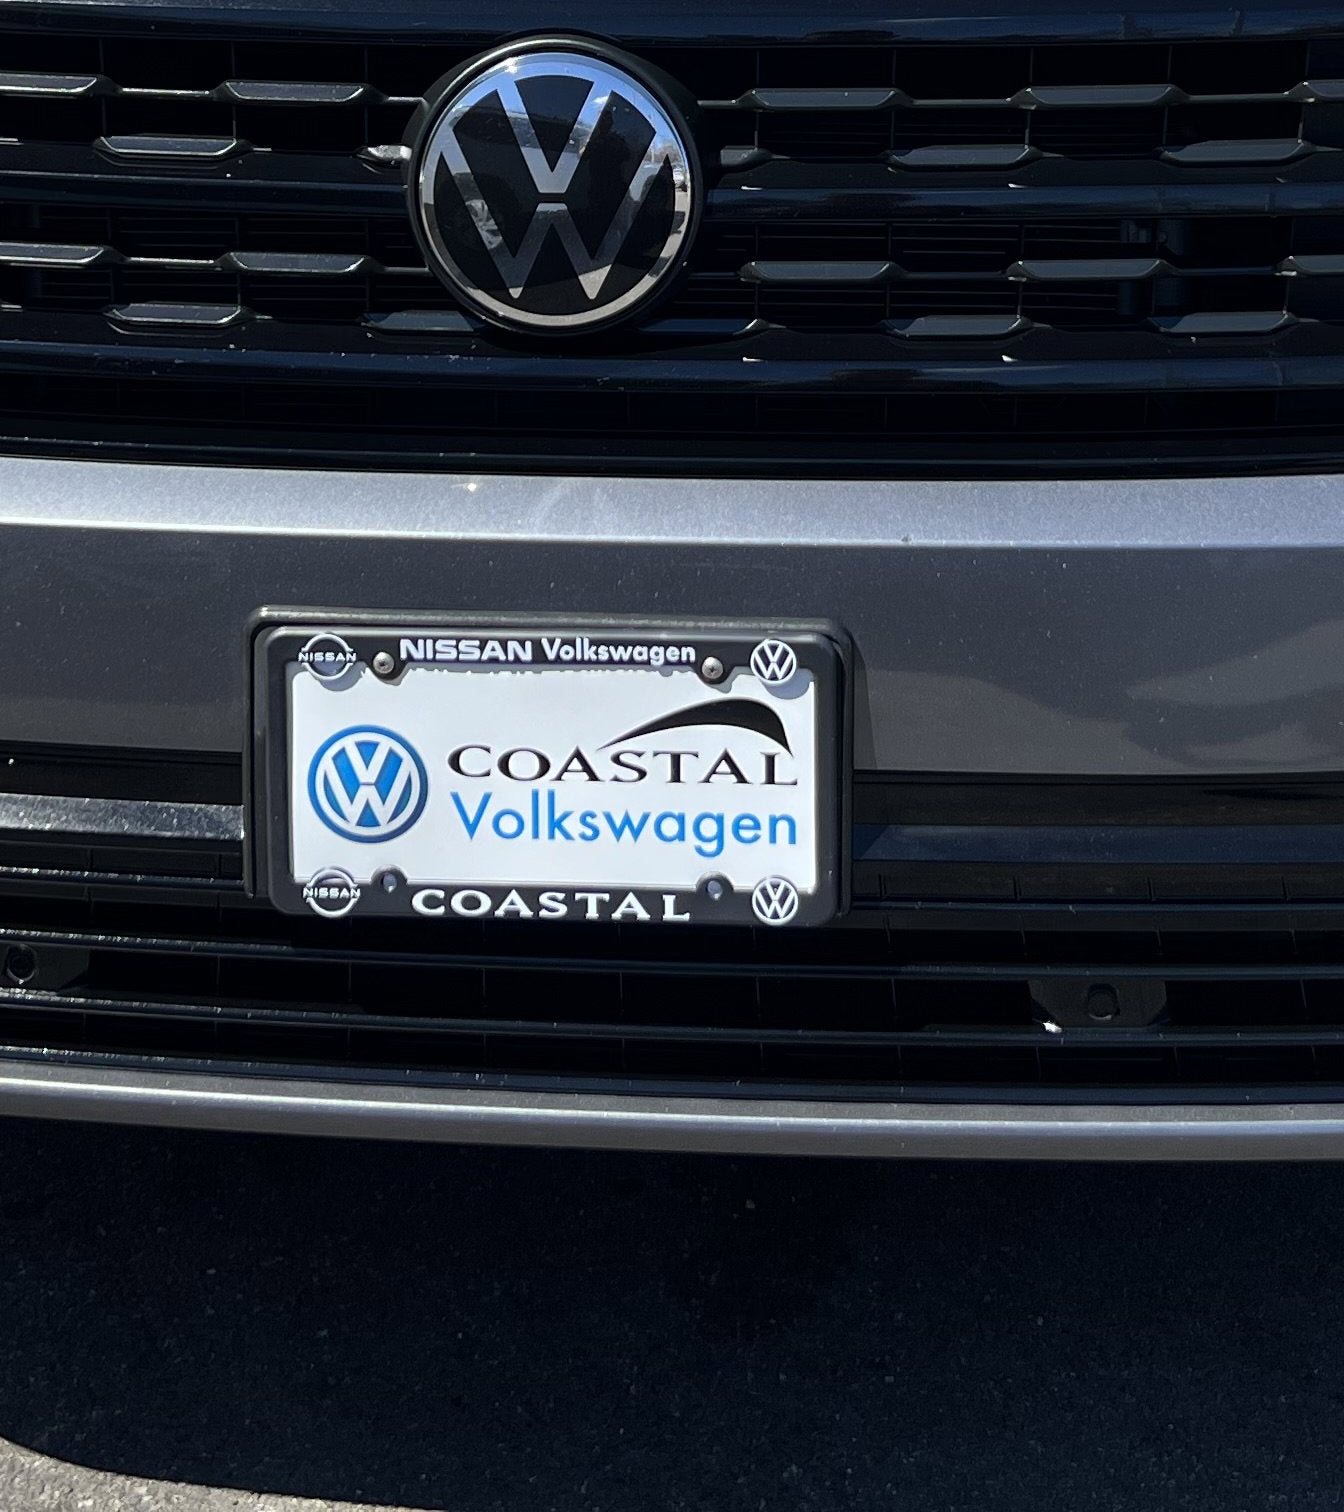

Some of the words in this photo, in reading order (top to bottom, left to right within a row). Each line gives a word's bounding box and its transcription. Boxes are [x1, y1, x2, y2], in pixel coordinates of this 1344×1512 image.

[432, 64, 680, 310] VW
[297, 651, 357, 663] NISSAN
[399, 638, 533, 662] NISSAN
[541, 636, 696, 666] Volkswagen
[750, 639, 797, 685] VW
[314, 732, 422, 836] VW
[447, 743, 798, 786] COASTAL
[450, 788, 797, 858] Volkswagen
[302, 887, 361, 900] NISSAN
[411, 888, 690, 922] COASTAL
[752, 878, 799, 925] VW
